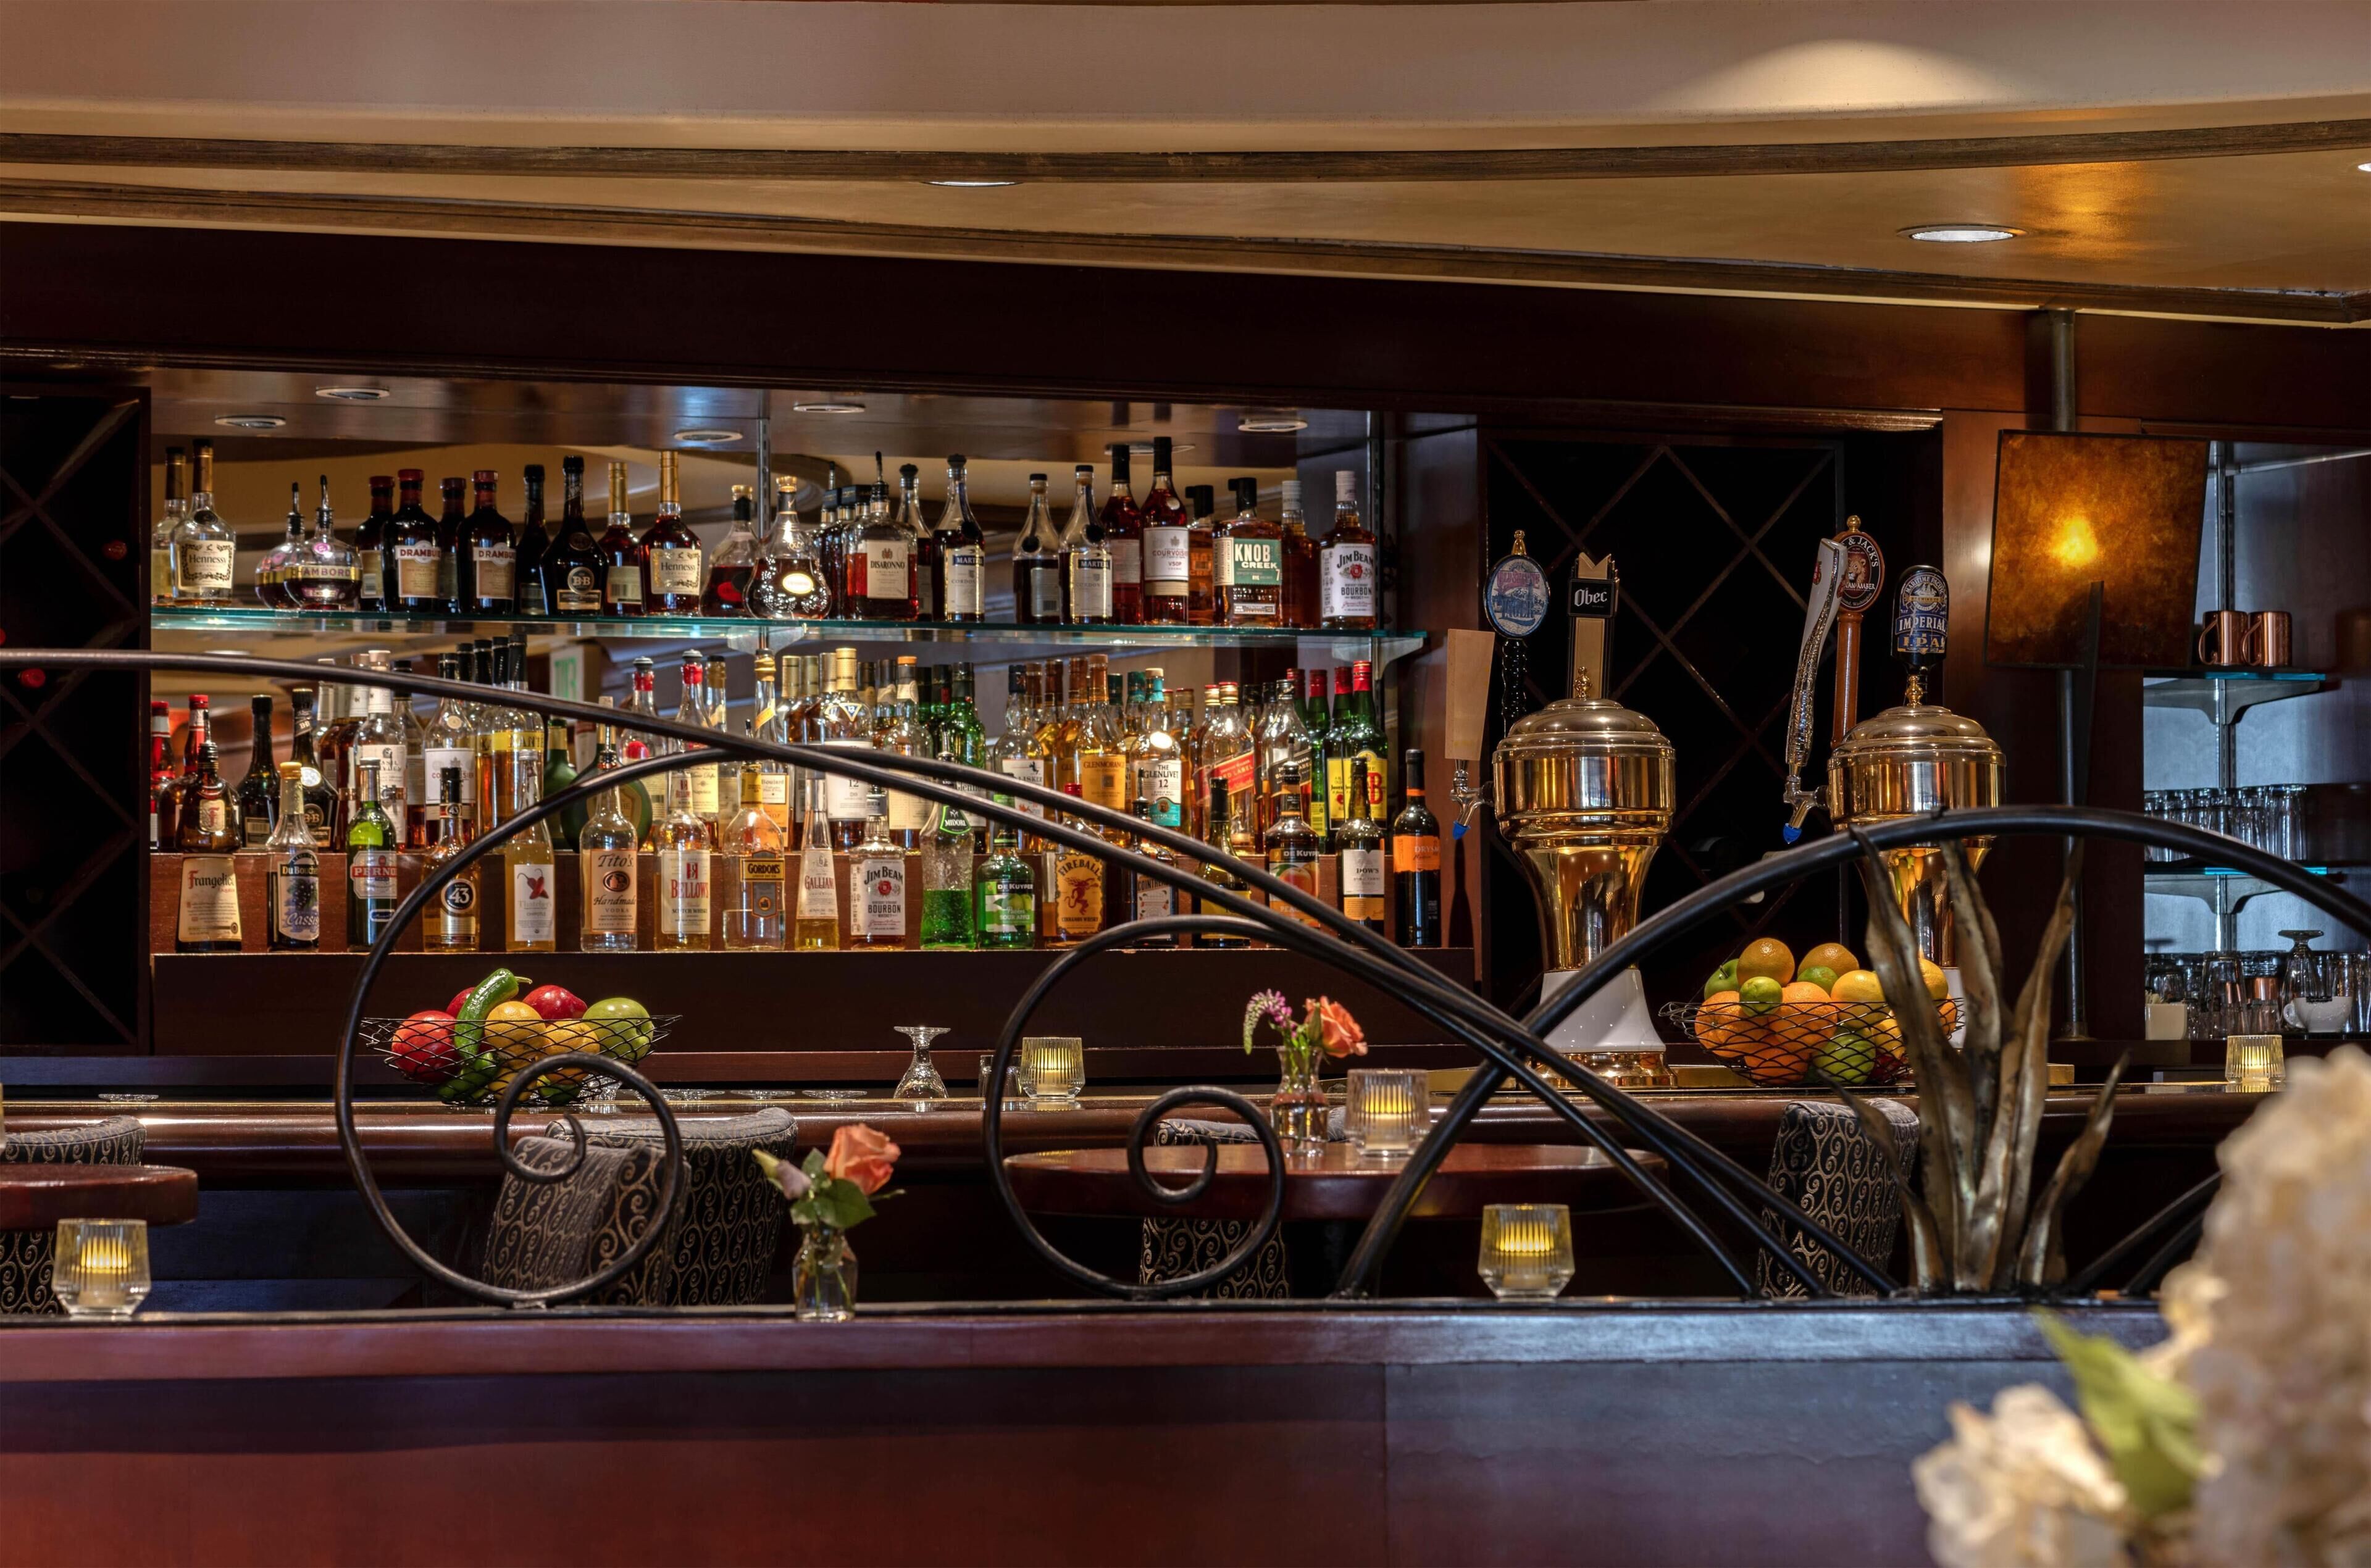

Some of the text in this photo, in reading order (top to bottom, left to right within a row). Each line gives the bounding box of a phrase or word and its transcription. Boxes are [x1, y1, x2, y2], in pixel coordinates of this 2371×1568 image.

[1235, 543, 1271, 562] KNOB
[1857, 537, 1879, 567] JACK'S
[870, 561, 905, 569] DISARONNO
[1337, 554, 1352, 568] JIM
[1276, 568, 1281, 582] 7
[1340, 586, 1372, 596] BOURBON
[1905, 576, 1944, 594] MARITIME PACIFIC
[1574, 587, 1608, 607] Obec
[1899, 616, 1946, 632] IMPERIAL
[1144, 770, 1179, 778] GLENLIVET
[848, 779, 859, 788] 12
[1159, 779, 1168, 788] 12
[598, 853, 634, 867] Tito's
[1058, 859, 1101, 877] FIREBALL
[188, 870, 235, 890] Frangelico
[864, 869, 880, 885] JIM
[449, 887, 469, 903] 43
[671, 879, 709, 899] BELLOWS
[868, 904, 901, 914] BOURBON
